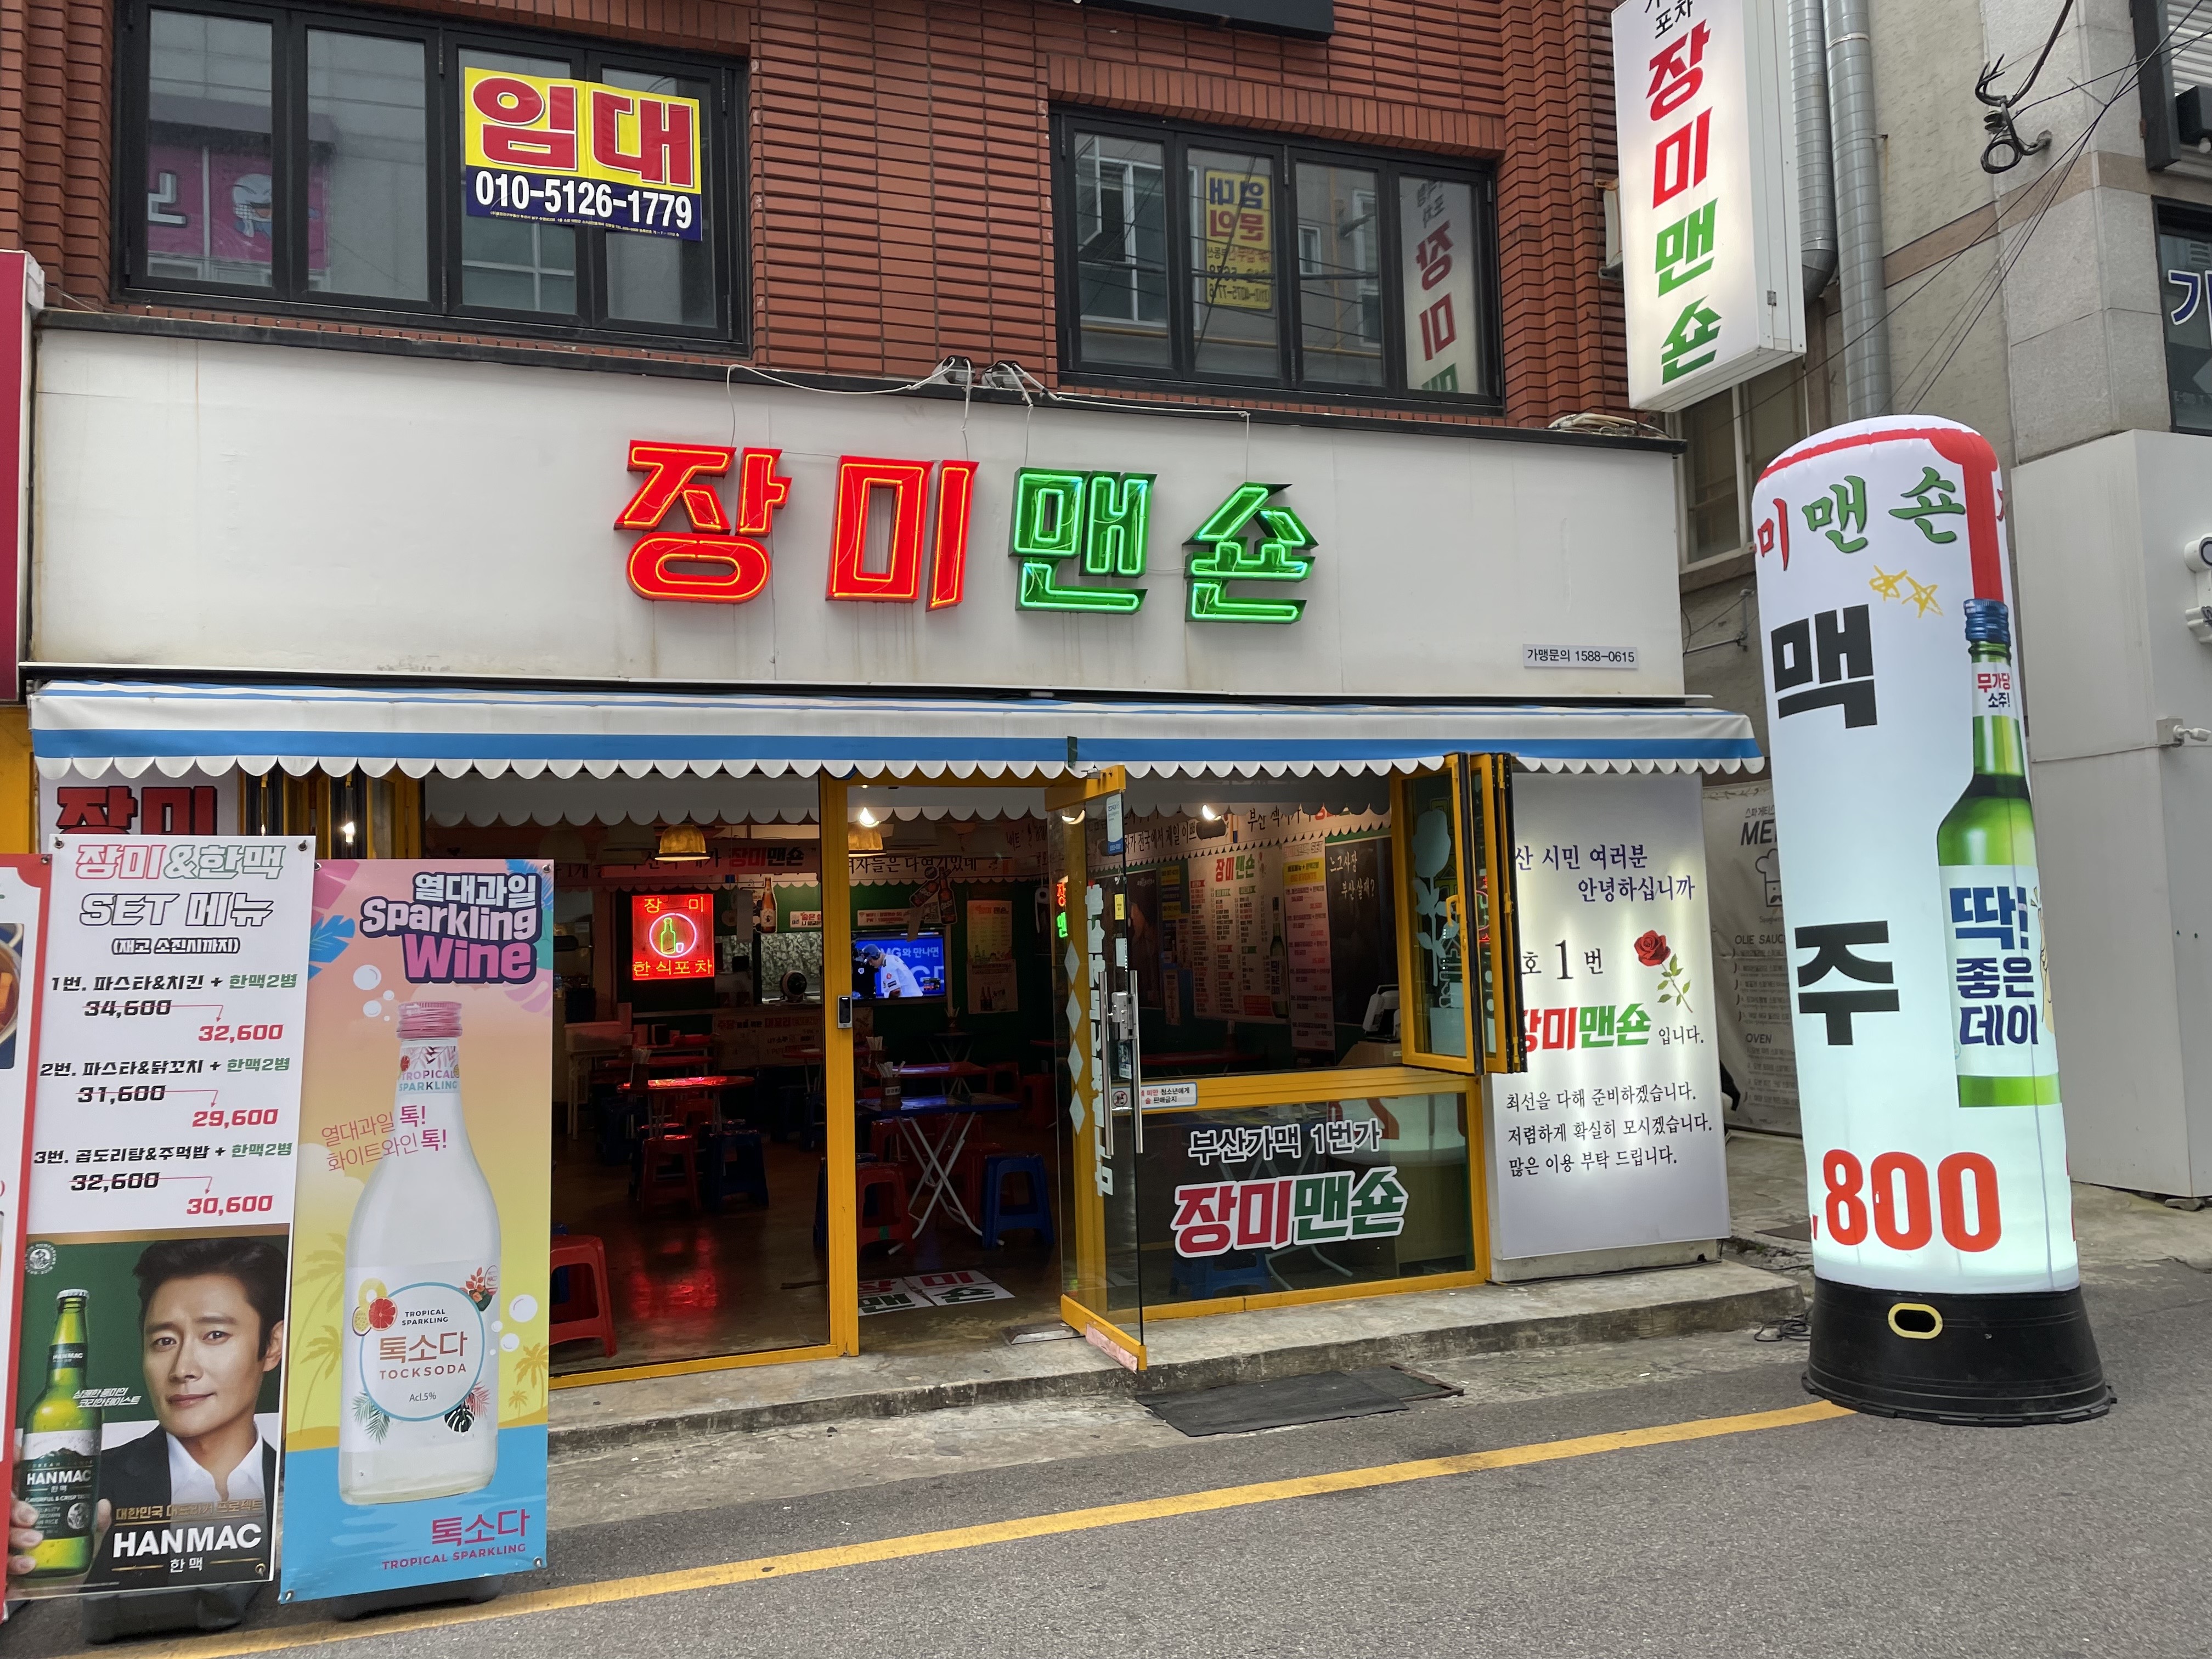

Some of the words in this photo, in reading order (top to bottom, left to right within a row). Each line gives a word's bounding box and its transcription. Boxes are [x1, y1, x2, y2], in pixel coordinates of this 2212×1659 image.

[472, 77, 695, 188] 임대
[475, 171, 692, 229] 010-5126-1779
[1646, 19, 1722, 385] 장미맨숀
[613, 439, 1318, 622] 장미맨숀
[1756, 467, 1966, 571] 미맨숀
[1527, 649, 1570, 662] 가맹문의
[1575, 651, 1634, 662] 1588-0615
[1978, 673, 2011, 693] 무가당
[1988, 692, 2011, 708] 소주!
[1741, 819, 1777, 846] ME
[76, 844, 285, 880] 장미&한맥
[1515, 848, 1533, 871] 산
[1542, 845, 1580, 871] 시민
[1590, 845, 1647, 869] 여러분
[414, 873, 537, 909] 열대과일
[1578, 876, 1696, 902] 안녕하십니까
[80, 893, 180, 927] SET
[185, 892, 273, 928] 메뉴
[363, 898, 537, 941] Sparkling
[1950, 887, 2029, 950] 딱!
[111, 938, 152, 955] (재고
[154, 938, 240, 955] 소진시까지)
[1735, 935, 1754, 945] OLIE
[1759, 934, 1786, 945] SAUC
[404, 934, 532, 980] Wine
[1521, 951, 1542, 976] 호
[52, 976, 87, 992] 1번.
[93, 975, 204, 991] 파스타&치킨
[229, 973, 298, 989] 한맥2병
[1956, 957, 2035, 998] 좋은
[83, 999, 172, 1019] 34,600
[198, 1024, 283, 1044] 32,600
[1658, 1026, 1705, 1046] 입니다.
[1746, 1034, 1772, 1043] OVEN
[1959, 1006, 2039, 1046] 데이
[40, 1062, 77, 1078] 2번.
[82, 1059, 204, 1076] 파스타&닭꼬치
[227, 1057, 291, 1073] 한맥2병
[401, 1070, 455, 1081] TROPICAL
[77, 1085, 166, 1105] 31,600
[398, 1080, 458, 1092] SPARKLING
[1507, 1090, 1550, 1112] 최선을
[1557, 1087, 1585, 1109] 다해
[1592, 1082, 1696, 1107] 준비하겠습니다.
[192, 1108, 279, 1129] 29,600
[321, 1111, 396, 1148] 열대과일
[399, 1105, 426, 1128] 톡!
[1508, 1121, 1567, 1144] 저렴하게
[1573, 1119, 1616, 1141] 확실히
[1623, 1113, 1712, 1136] 모시겠습니다.
[34, 1149, 69, 1165] 3번.
[231, 1142, 293, 1158] 한맥2병
[326, 1132, 419, 1172] 화이트와인
[421, 1128, 447, 1152] 톡!
[1188, 1125, 1301, 1165] 부산가맥
[1311, 1117, 1381, 1155] 1번가
[1509, 1155, 1539, 1177] 많은
[1545, 1153, 1575, 1174] 이용
[1581, 1150, 1610, 1171] 부탁
[1616, 1145, 1678, 1166] 드립니다.
[70, 1171, 160, 1192] 32,600
[186, 1195, 273, 1217] 30,600
[1171, 1166, 1409, 1258] 장미맨숀
[402, 1316, 449, 1326] SPARKLING
[404, 1308, 446, 1318] TROPICAL
[379, 1331, 467, 1364] 톡소다
[379, 1363, 467, 1380] TOCKSODA
[26, 1469, 92, 1486] HANMAC
[116, 1505, 163, 1520] 대한민국
[216, 1498, 263, 1513] 프로젝트
[113, 1523, 262, 1558] HANMAC
[432, 1508, 531, 1547] 톡소다
[382, 1553, 448, 1570] TROPICAL
[453, 1543, 526, 1561] SPARKLING
